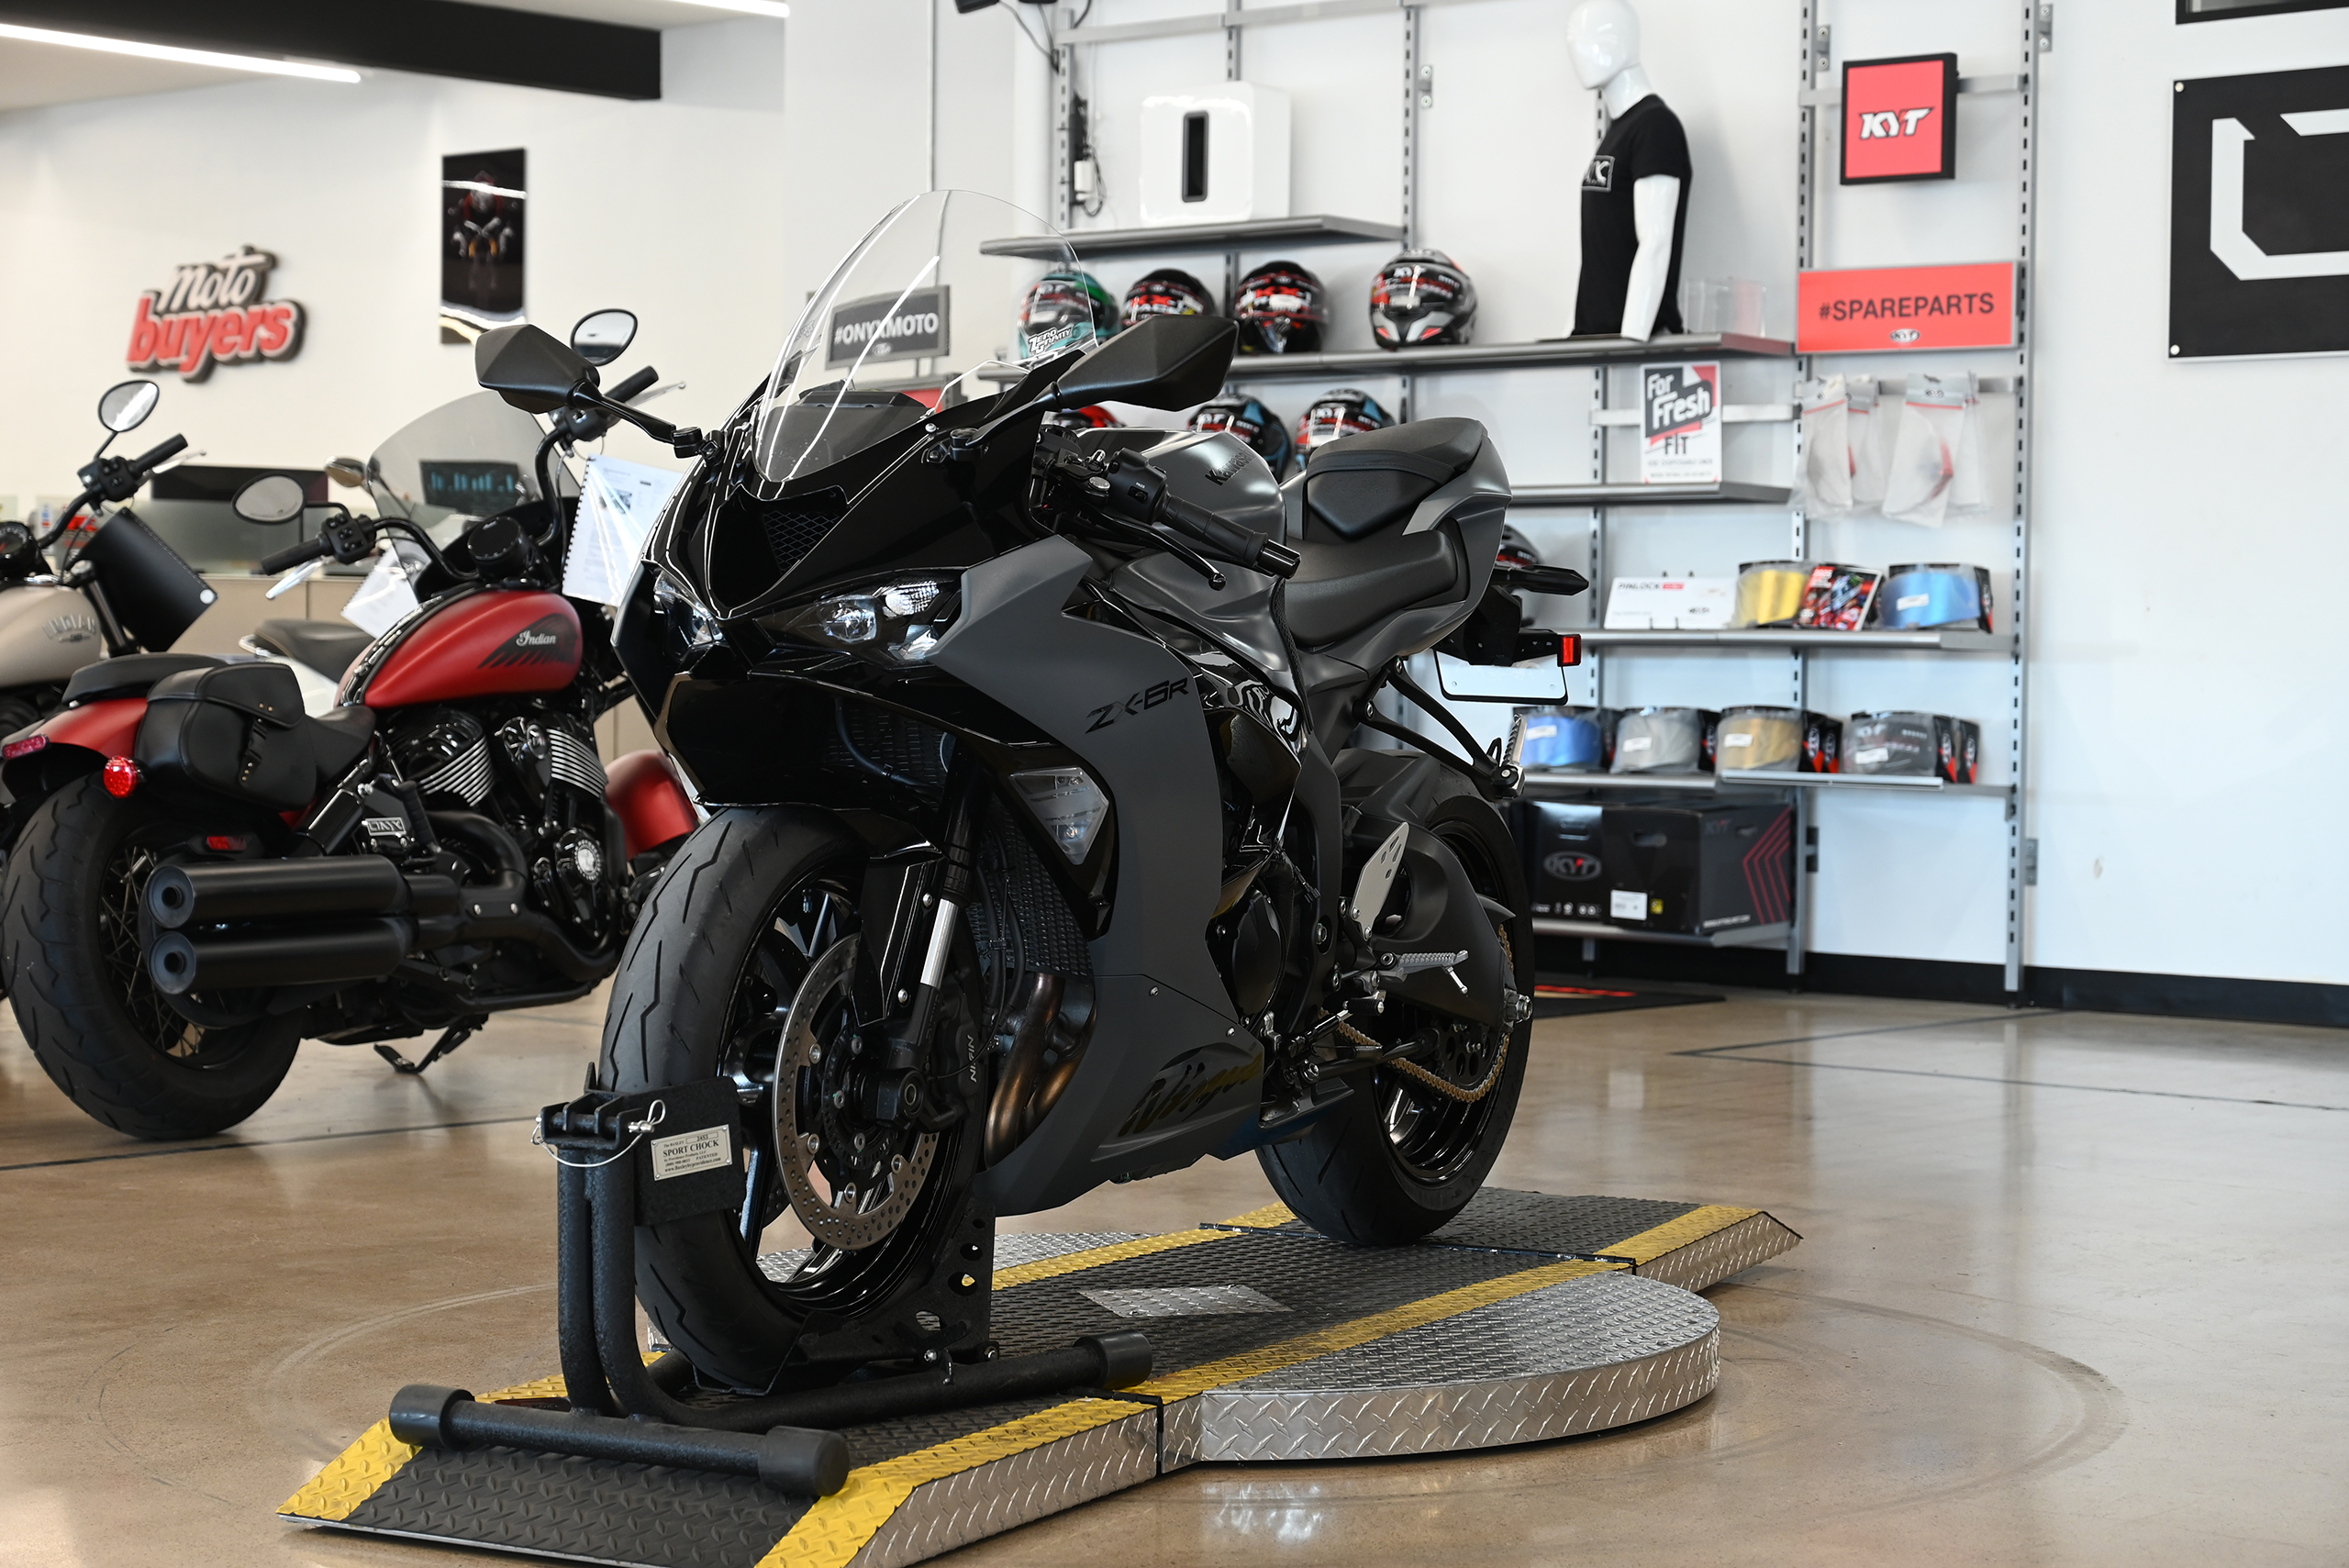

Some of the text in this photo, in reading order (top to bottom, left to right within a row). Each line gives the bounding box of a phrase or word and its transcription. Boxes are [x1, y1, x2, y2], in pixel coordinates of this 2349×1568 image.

[1859, 106, 1935, 139] KYT
[1819, 292, 1995, 321] #SPAREPARTS
[127, 295, 293, 373] buyers
[1029, 328, 1058, 352] ZERO
[1647, 373, 1675, 400] For
[1653, 386, 1711, 429] Fresh
[1664, 434, 1689, 455] FIT
[516, 629, 557, 647] Indian
[1085, 677, 1189, 735] ZX-6R
[1545, 855, 1598, 875] KYT
[662, 1139, 719, 1157] SPORT CHOCK
[696, 1152, 718, 1161] PATENTED
